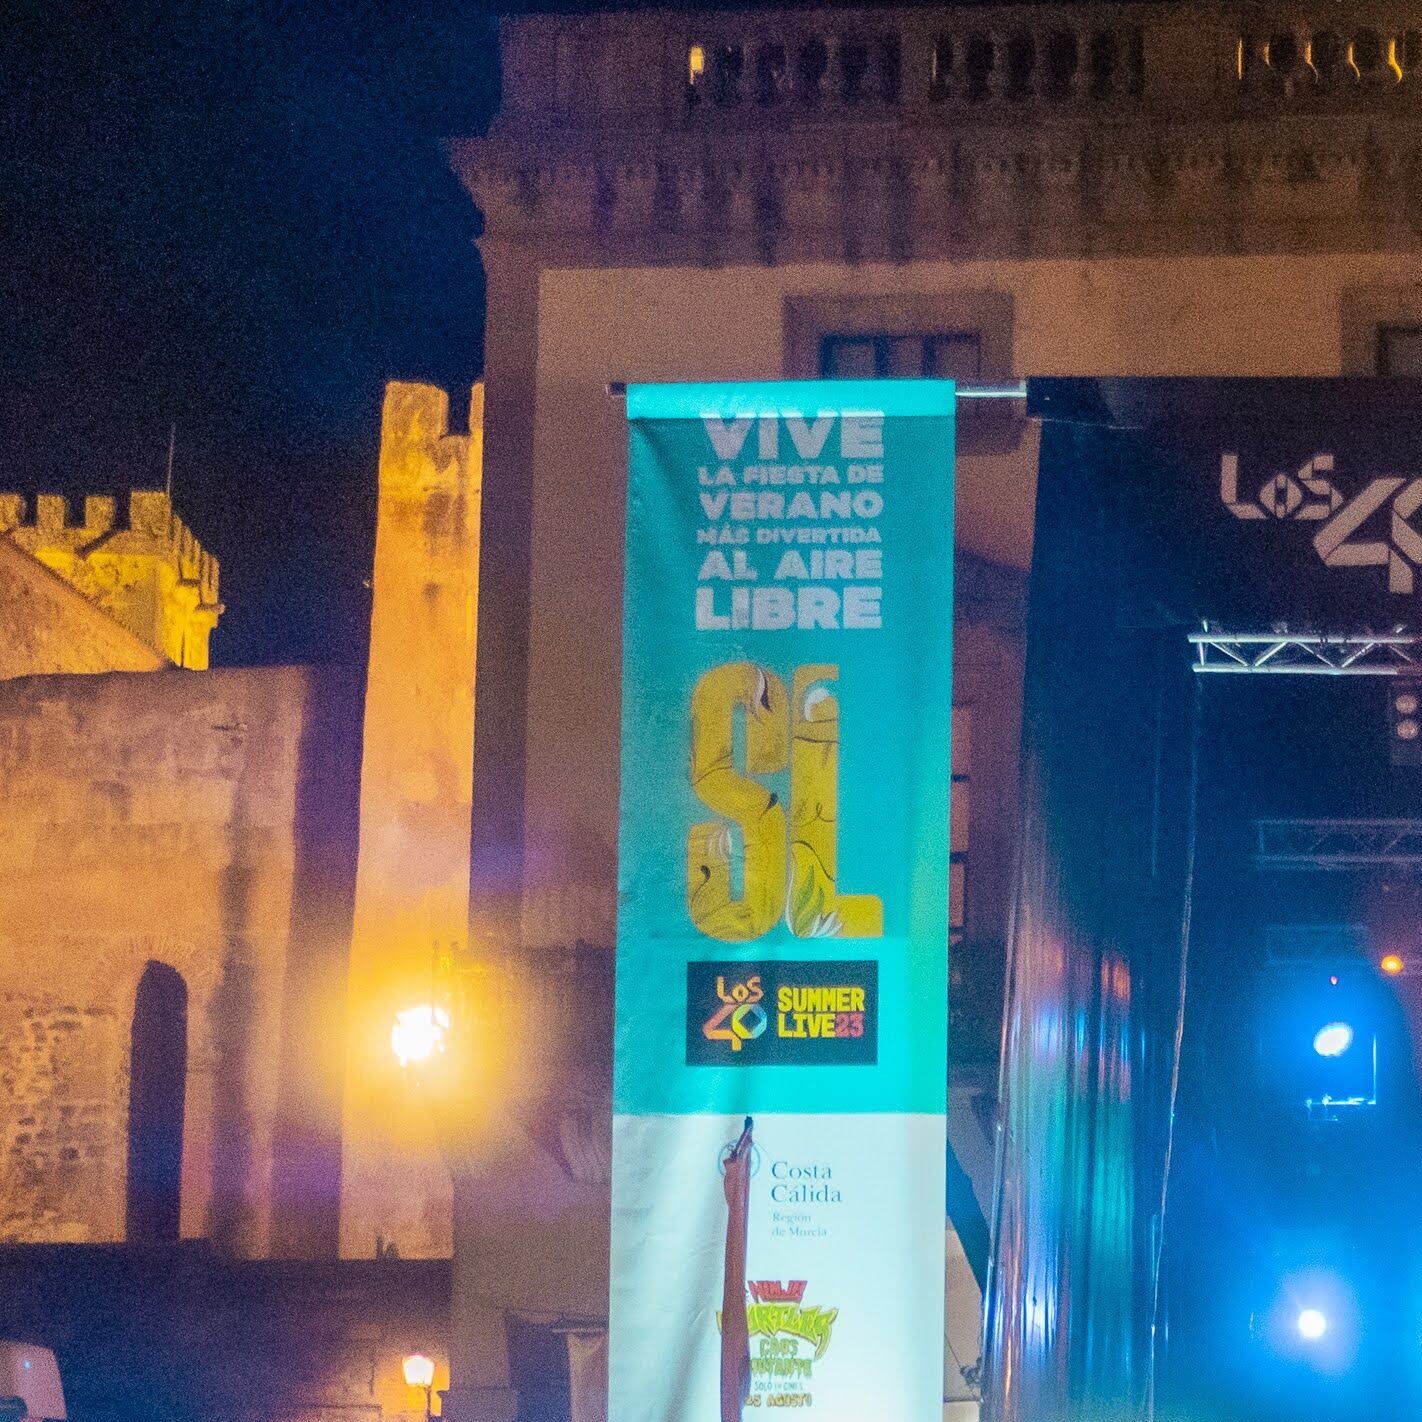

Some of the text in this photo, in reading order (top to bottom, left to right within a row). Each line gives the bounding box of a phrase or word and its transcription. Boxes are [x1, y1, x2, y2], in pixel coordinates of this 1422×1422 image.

[700, 411, 885, 461] VIVE
[699, 464, 885, 486] LA FIESTA DE
[699, 490, 885, 521] VERANO
[756, 527, 882, 545] DIVERTIDA
[698, 549, 883, 582] AL AIRE
[695, 586, 883, 631] LIBRE
[777, 986, 866, 1014] SUMMER
[703, 1003, 768, 1052] 40
[771, 1160, 833, 1180] Costa
[771, 1184, 843, 1204] Cálida
[788, 1227, 828, 1238] Murcia
